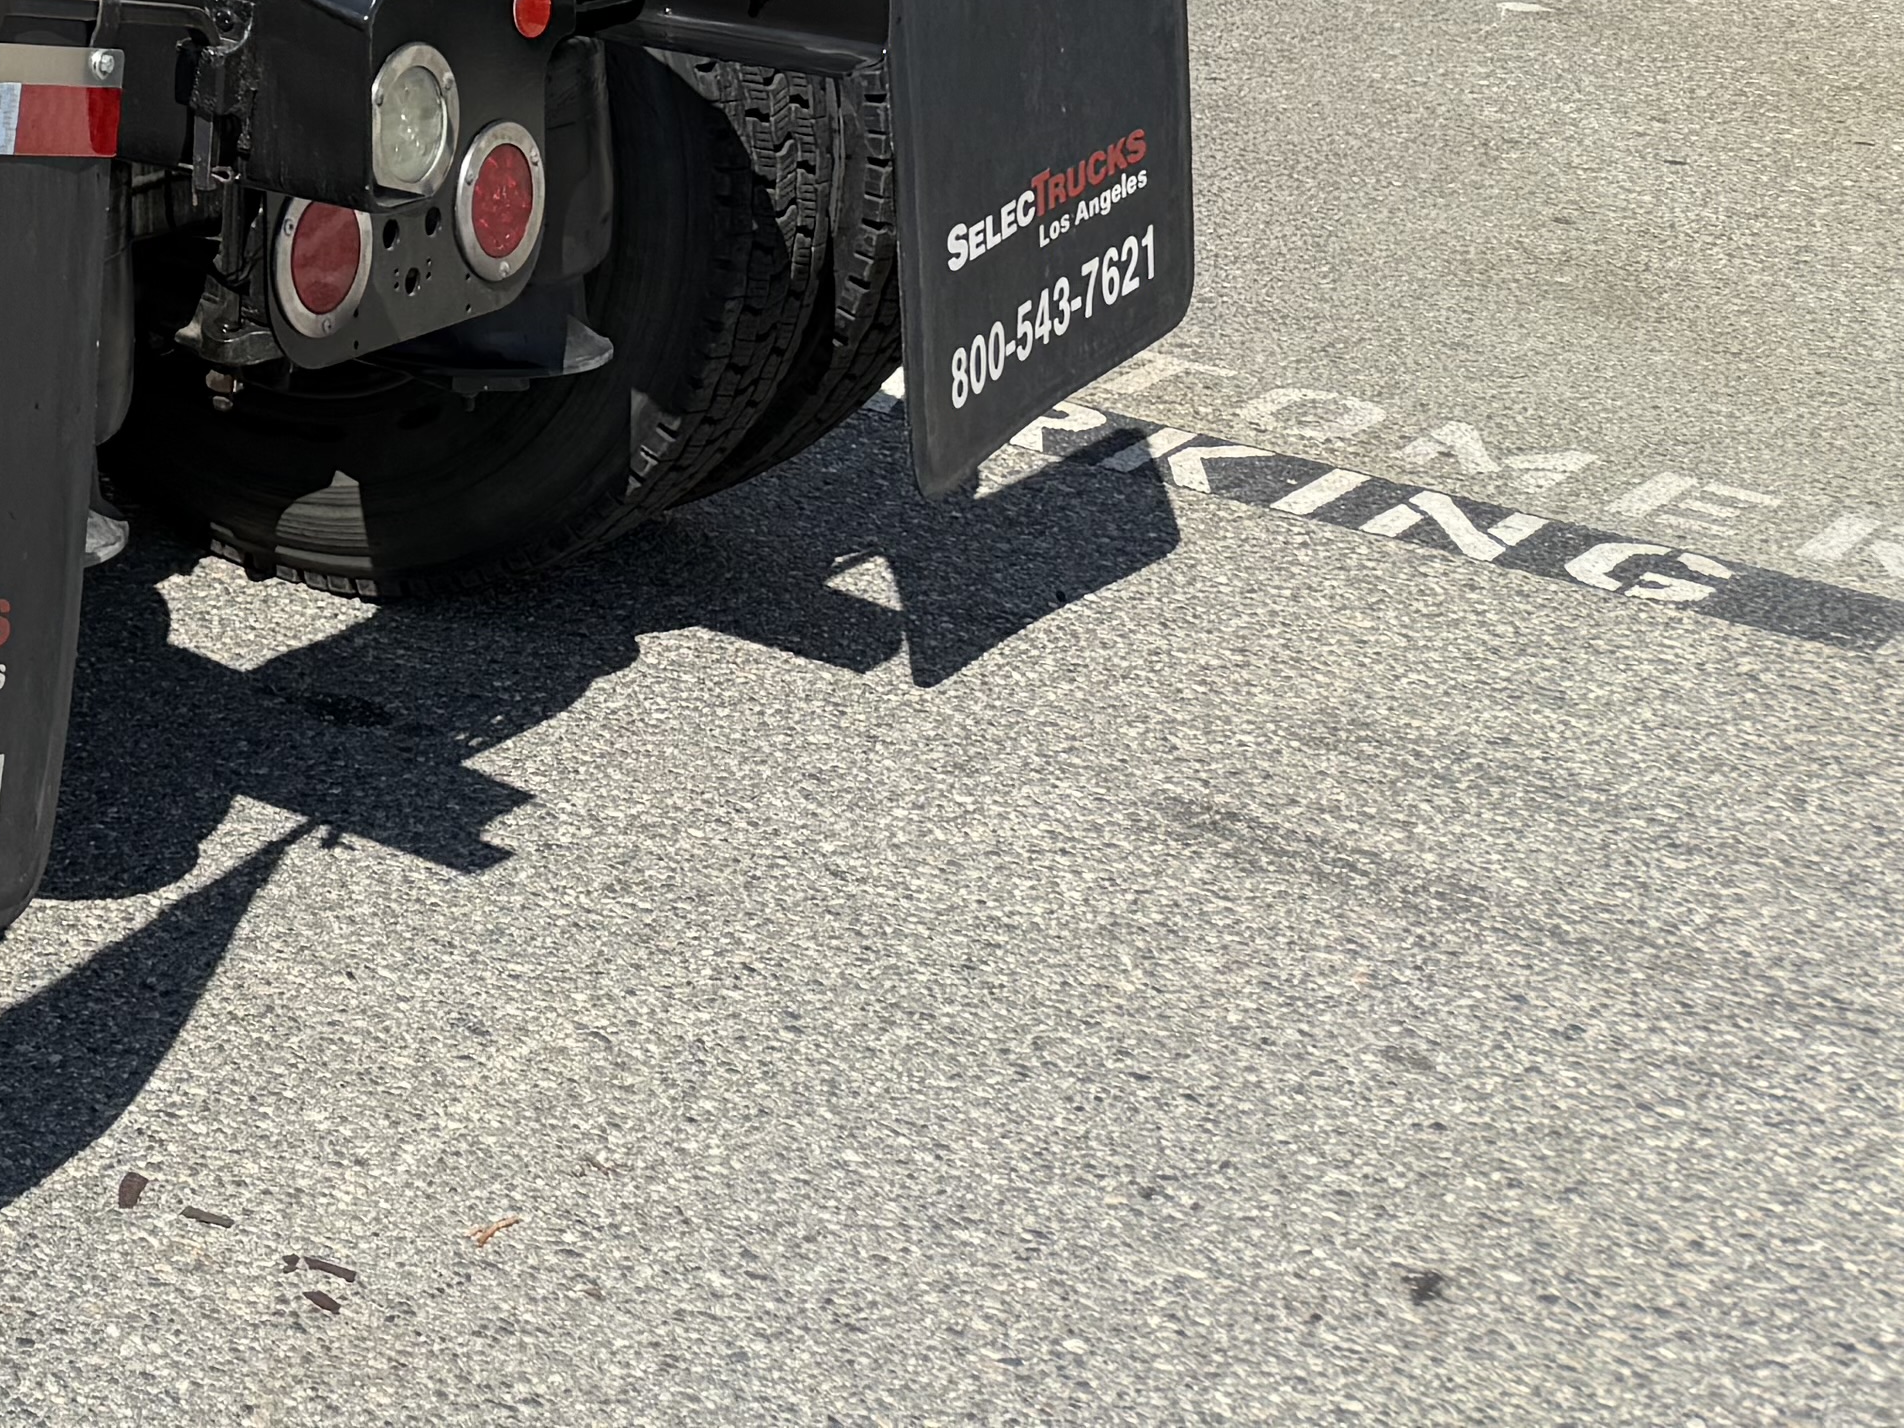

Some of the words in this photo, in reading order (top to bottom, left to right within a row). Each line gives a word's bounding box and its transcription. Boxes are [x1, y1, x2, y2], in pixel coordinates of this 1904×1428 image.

[947, 129, 1147, 271] SELECTRUCKS
[1039, 214, 1070, 248] Los
[1075, 169, 1148, 225] Angeles
[951, 224, 1155, 409] 800-543-7621
